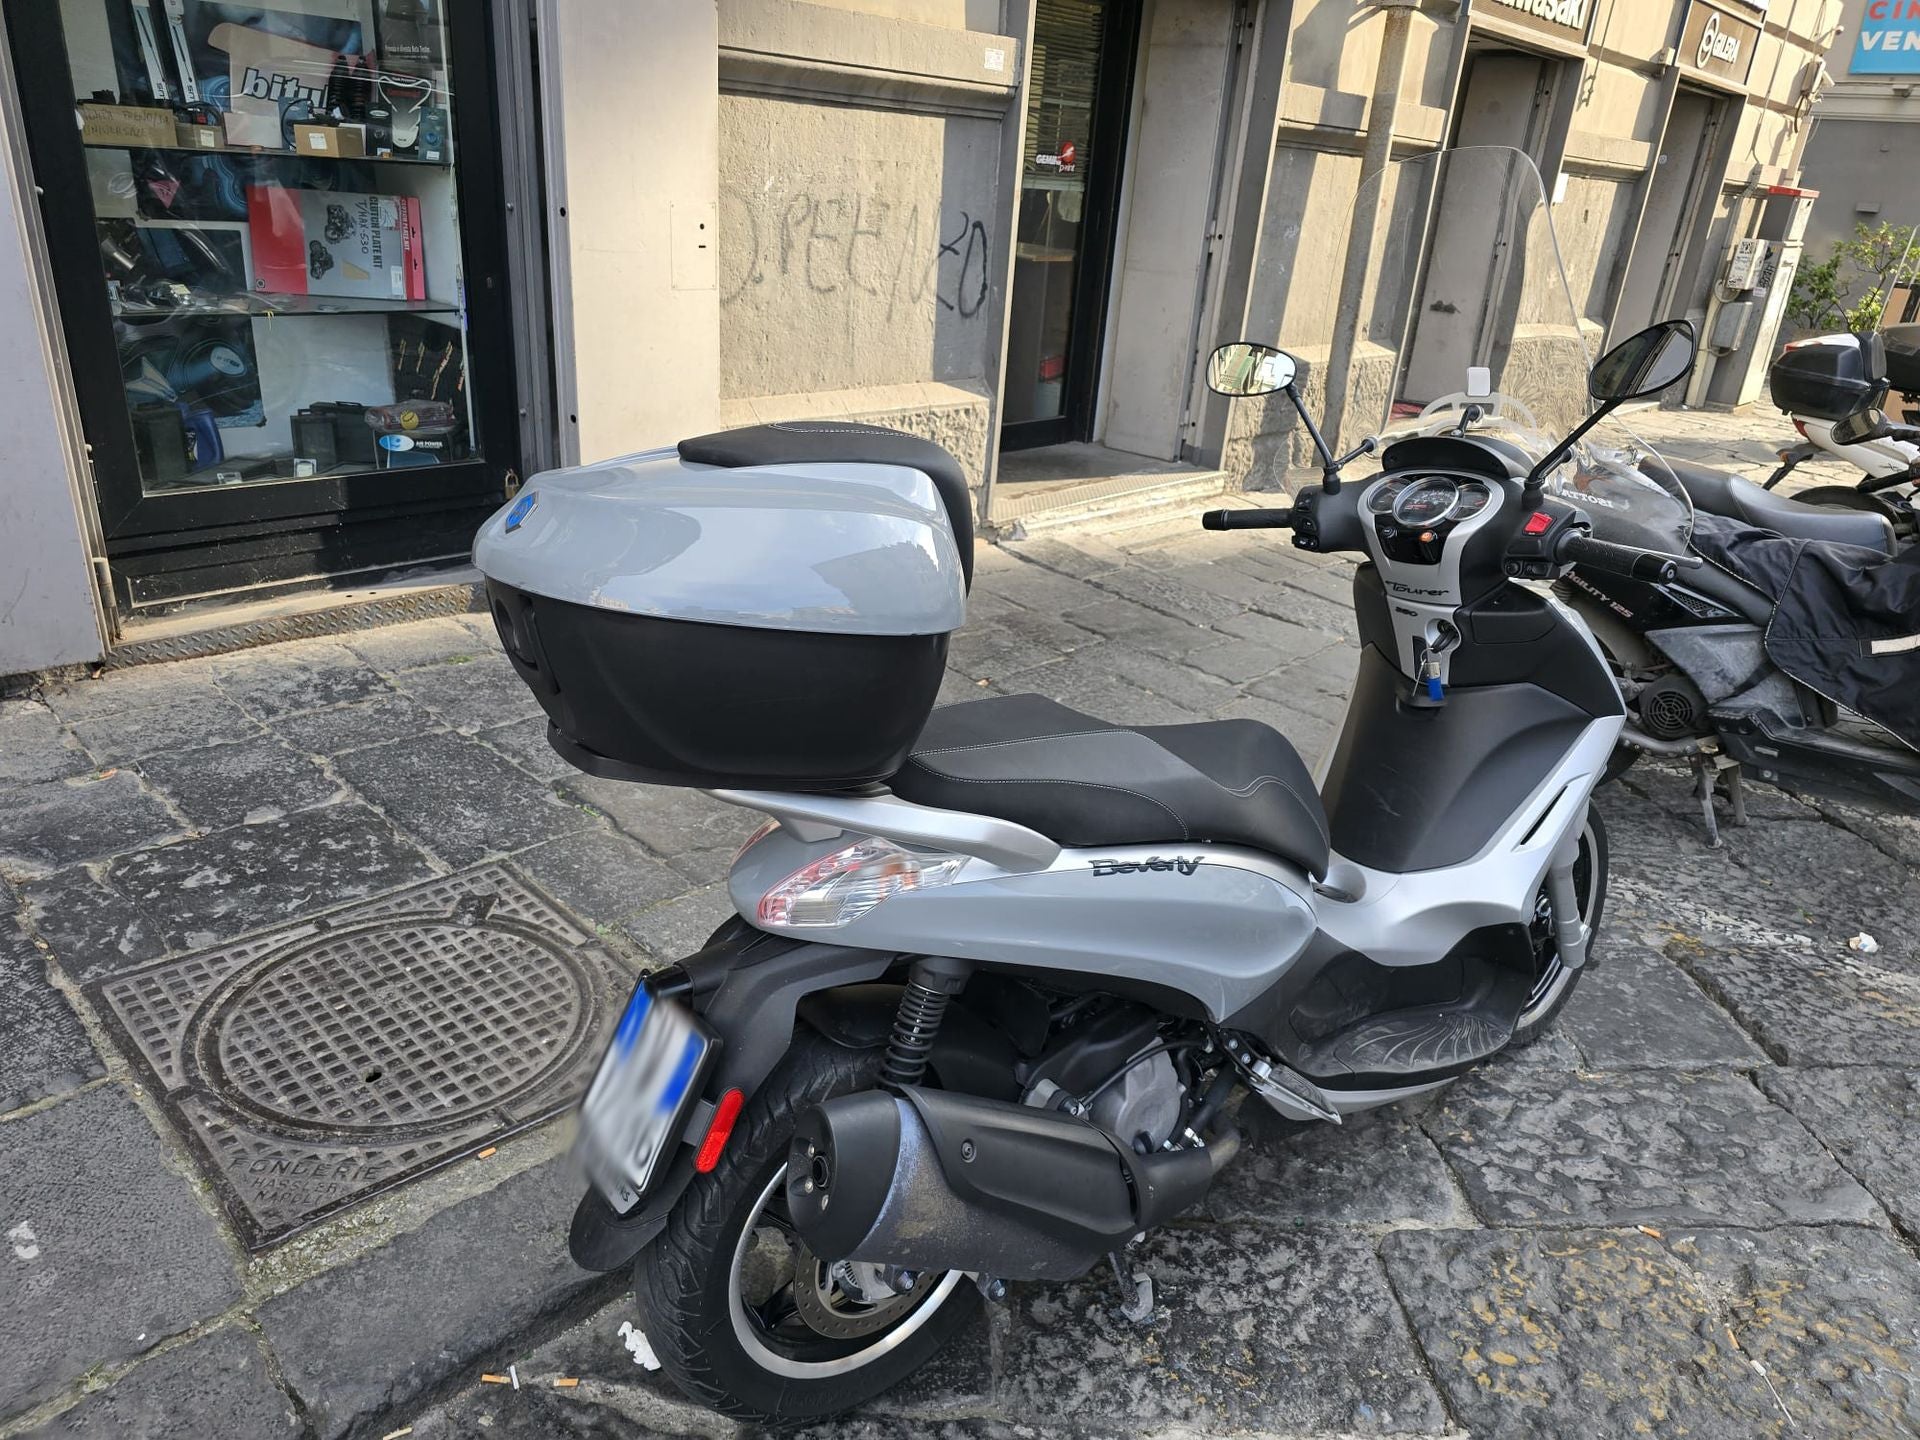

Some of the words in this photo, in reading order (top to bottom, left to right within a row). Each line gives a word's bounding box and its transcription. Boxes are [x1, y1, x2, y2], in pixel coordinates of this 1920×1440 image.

[1712, 32, 1741, 64] GILERA
[369, 196, 380, 229] CLUTCH
[371, 229, 382, 254] PLATE
[373, 255, 383, 270] KIT
[1384, 580, 1450, 597] Tourer
[1609, 601, 1635, 618] 125
[1088, 855, 1206, 877] Beverly
[228, 1157, 386, 1181] FONDERIE
